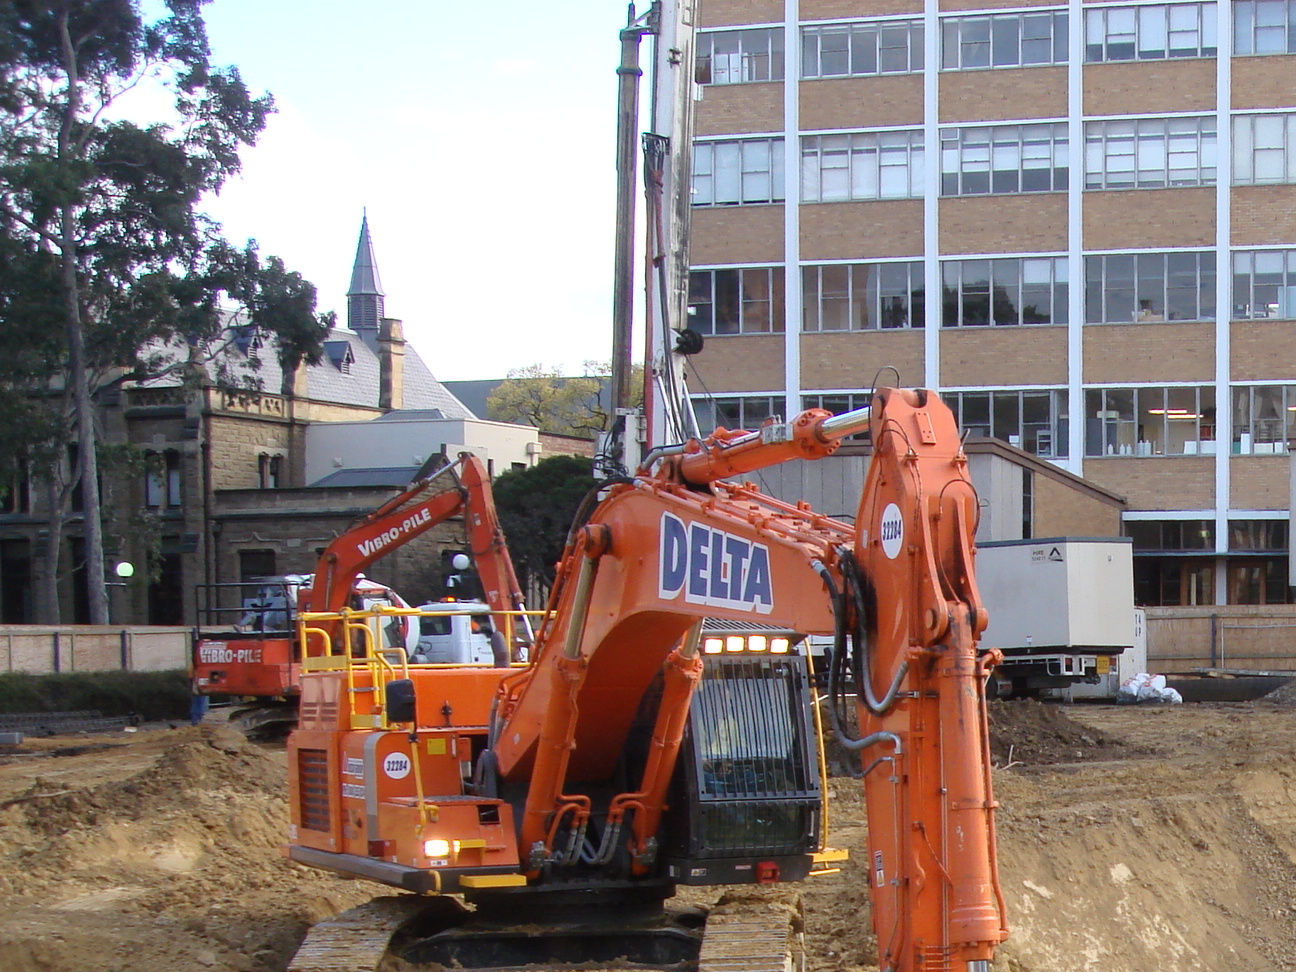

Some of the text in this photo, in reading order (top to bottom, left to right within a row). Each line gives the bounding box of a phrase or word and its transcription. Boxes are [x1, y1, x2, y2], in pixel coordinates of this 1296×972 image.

[357, 508, 432, 557] VIBRO-PILE
[882, 519, 902, 541] 32284
[660, 512, 773, 611] DELTA
[386, 760, 408, 772] 32284
